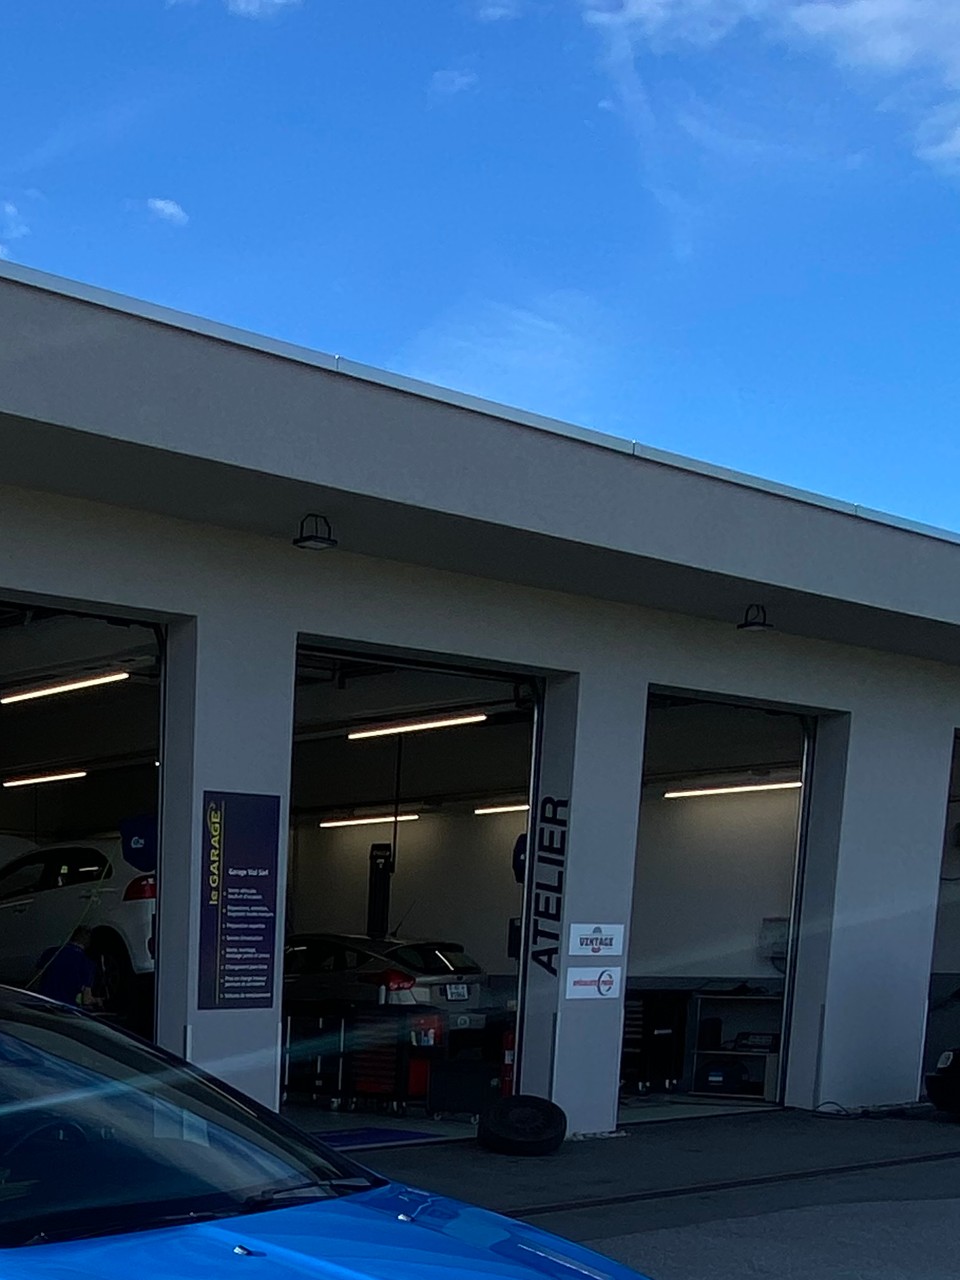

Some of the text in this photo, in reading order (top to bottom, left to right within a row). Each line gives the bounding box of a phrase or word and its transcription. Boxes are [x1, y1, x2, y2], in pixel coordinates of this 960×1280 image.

[209, 810, 221, 888] GARAGE
[531, 796, 569, 977] ATELIER
[579, 936, 614, 947] VINTAGE
